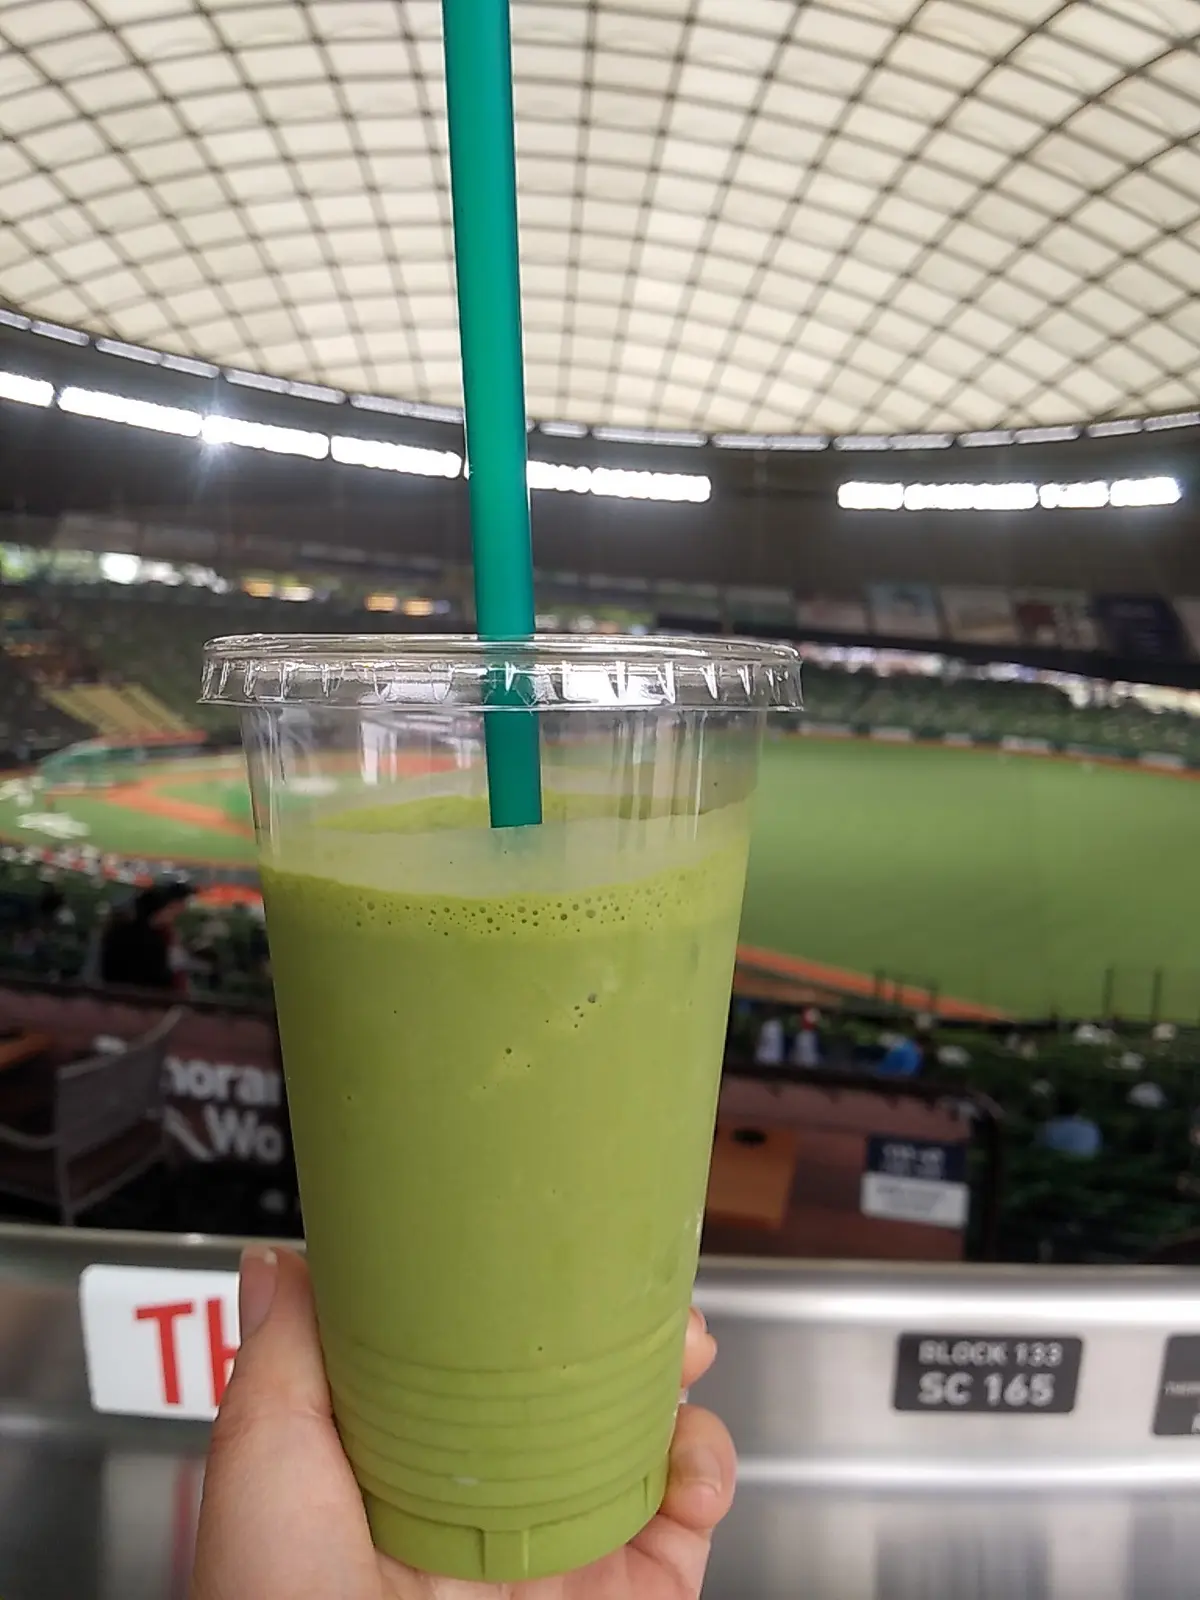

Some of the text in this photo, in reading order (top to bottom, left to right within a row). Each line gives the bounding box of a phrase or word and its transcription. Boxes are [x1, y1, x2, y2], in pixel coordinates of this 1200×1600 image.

[136, 1299, 237, 1406] TH
[918, 1340, 1063, 1367] BLOCK 133
[918, 1371, 1055, 1407] SC 165
